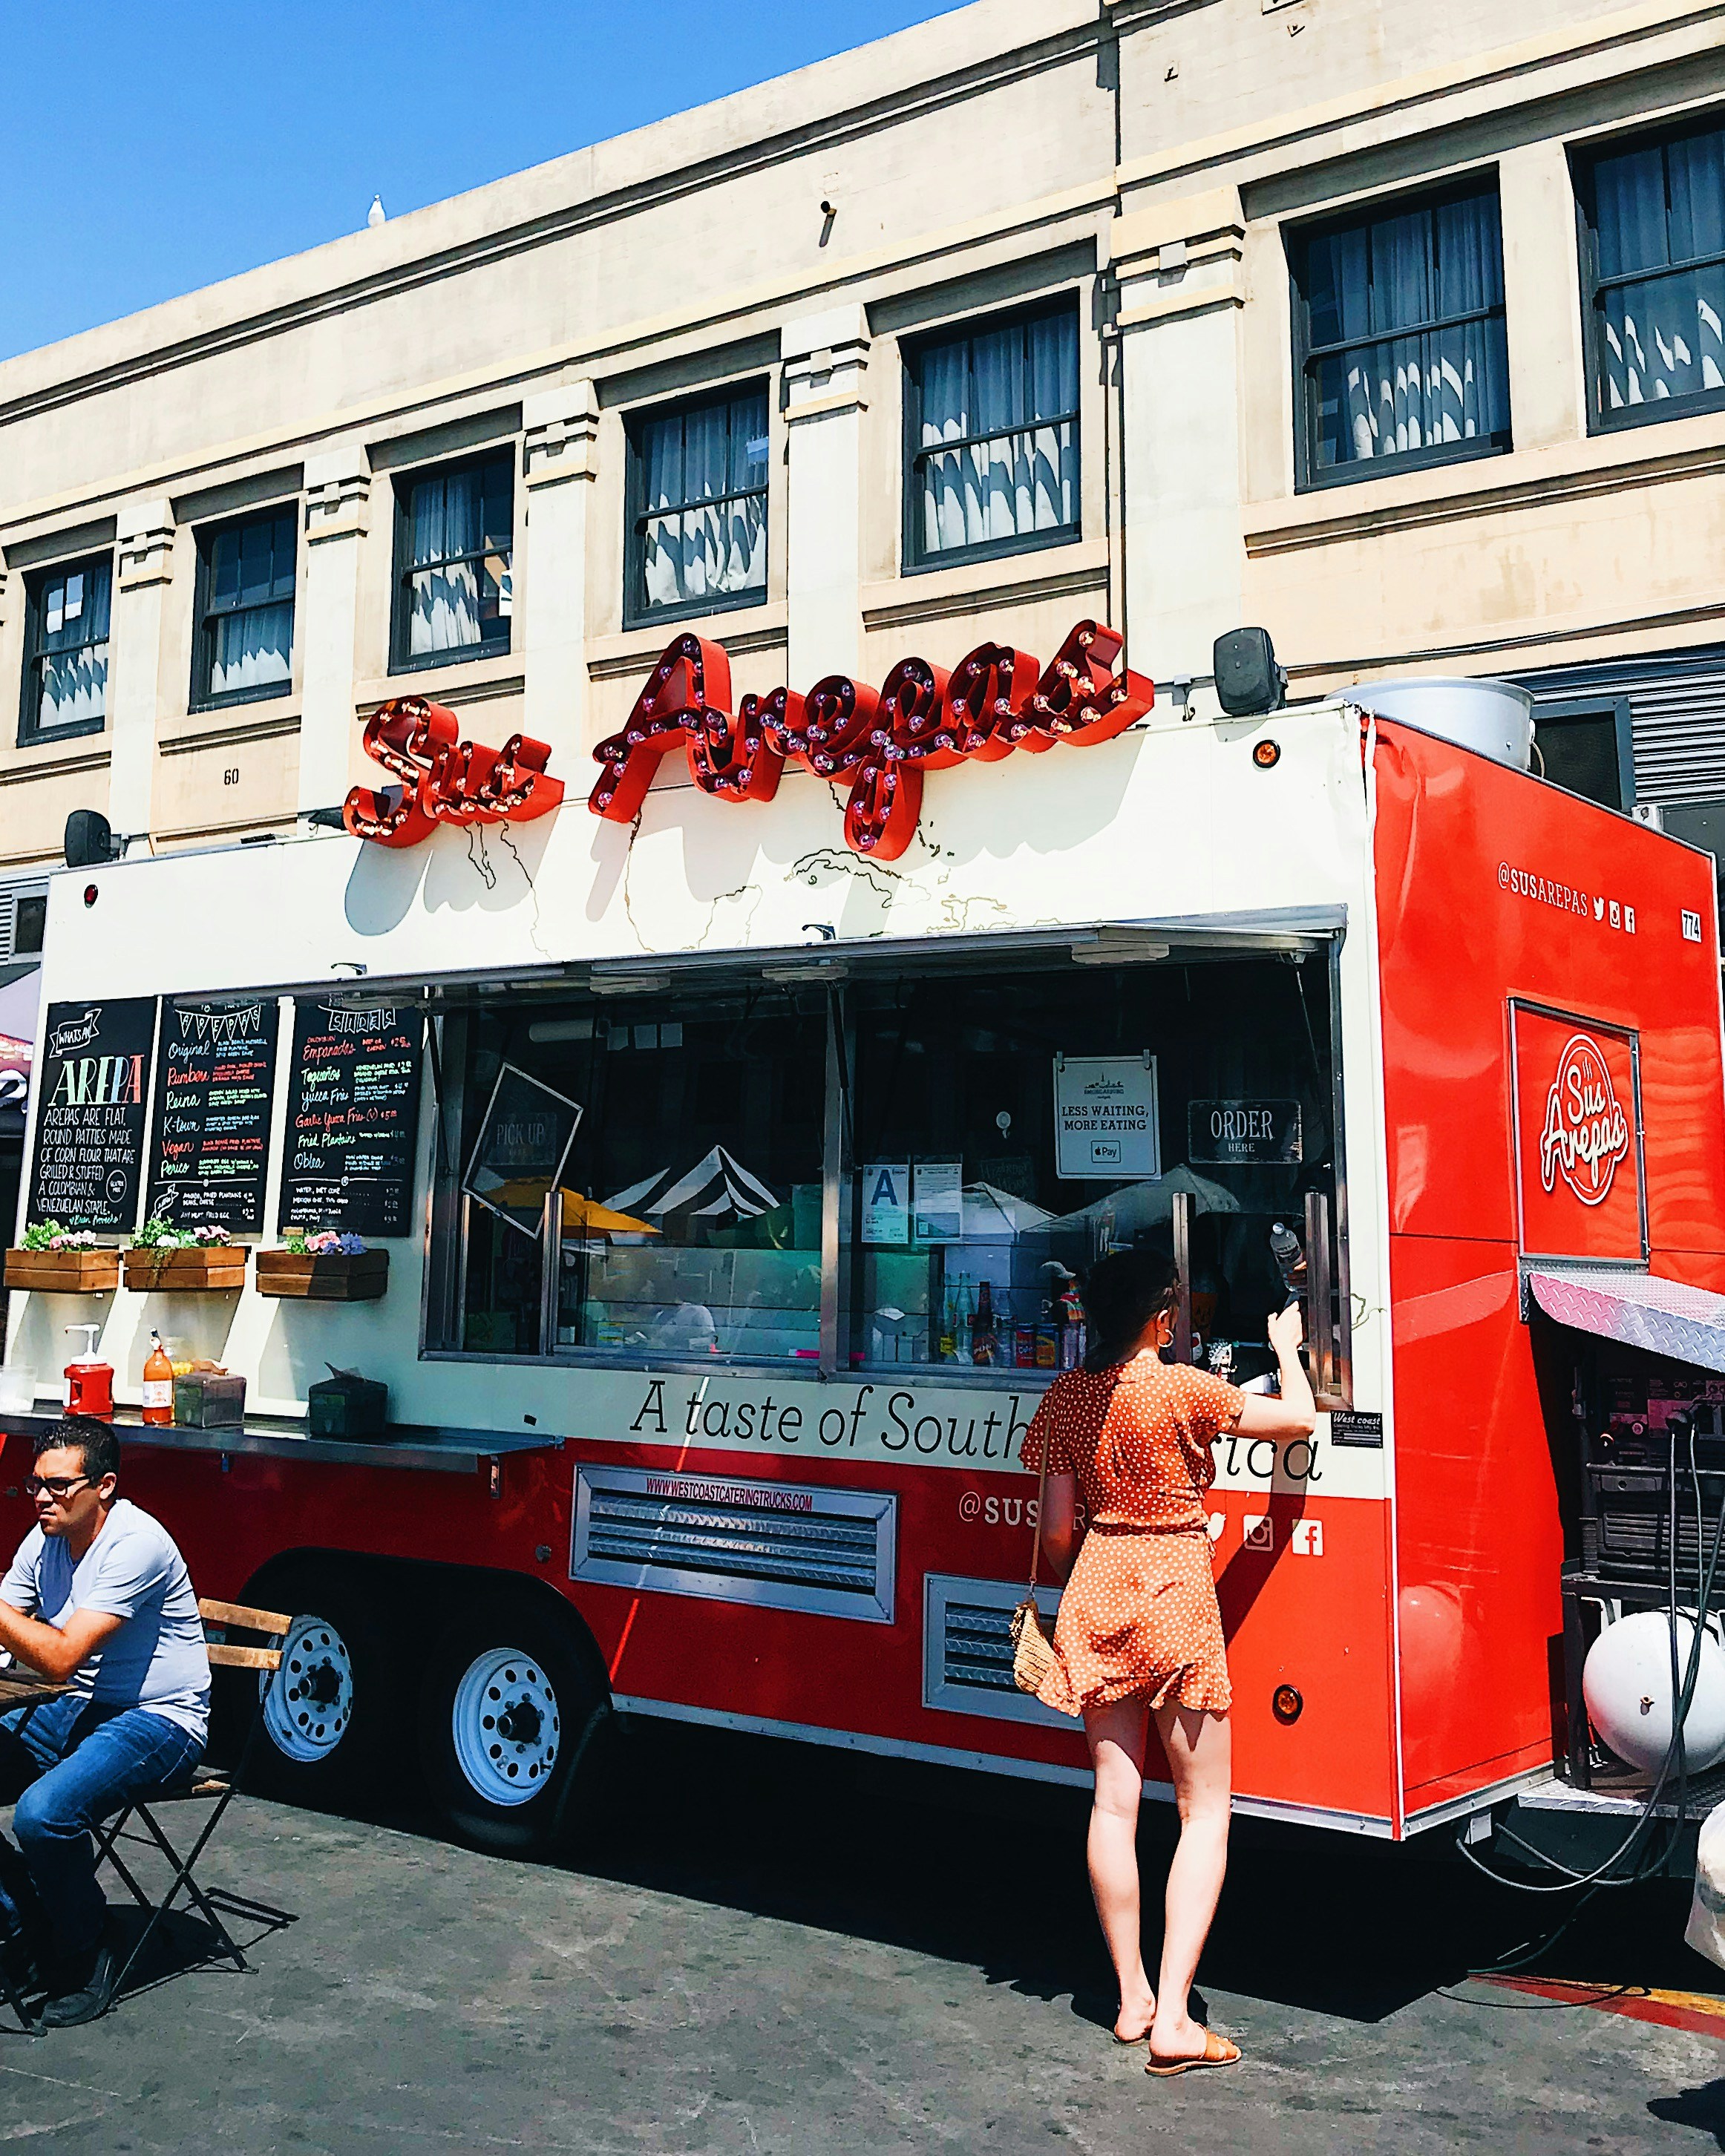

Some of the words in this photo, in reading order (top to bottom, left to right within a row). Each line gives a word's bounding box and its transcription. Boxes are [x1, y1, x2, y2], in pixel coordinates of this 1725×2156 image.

[587, 618, 1155, 862] Arepas
[223, 767, 239, 785] 60
[1497, 862, 1588, 917] @SUSAREPAS
[1683, 913, 1700, 939] 774
[168, 1040, 210, 1064] Original
[303, 1039, 356, 1065] Empanadas
[48, 1054, 145, 1107] AREPA
[166, 1091, 201, 1110] Reina
[1567, 1064, 1606, 1124] Sus
[43, 1107, 80, 1127] AREPAS
[82, 1107, 101, 1126] ARE
[295, 1113, 322, 1128] Garlic
[1061, 1106, 1088, 1117] LESS
[1090, 1104, 1150, 1118] WAITING,
[163, 1115, 200, 1136] K-town
[497, 1123, 524, 1146] PICK
[528, 1122, 546, 1147] UP
[1064, 1120, 1099, 1131] MORE
[1100, 1119, 1147, 1130] EATING
[1210, 1110, 1274, 1141] ORDER
[43, 1128, 73, 1145] ROUND
[75, 1127, 106, 1144] PATTIES
[108, 1129, 133, 1144] MADE
[298, 1133, 319, 1148] Fried
[321, 1132, 356, 1148] Plantains
[1544, 1093, 1625, 1189] Arepas
[40, 1147, 53, 1163] OF
[54, 1147, 77, 1163] CORN
[79, 1148, 101, 1163] FLOUR
[104, 1148, 122, 1163] THAT
[122, 1149, 136, 1164] ARE
[162, 1139, 194, 1161] Vegan
[1102, 1147, 1117, 1158] Pay
[1228, 1143, 1255, 1153] HERE
[160, 1160, 189, 1178] Perico
[293, 1152, 325, 1170] Oblea
[39, 1164, 68, 1179] GRILLED
[75, 1165, 105, 1181] STUFFED
[38, 1181, 46, 1196] A
[871, 1169, 898, 1206] A
[36, 1198, 84, 1213] VENEZUELAN
[629, 1380, 668, 1433] A
[685, 1391, 803, 1444] taste
[819, 1385, 874, 1447] of
[880, 1392, 1031, 1459] South
[1333, 1412, 1355, 1423] West
[1357, 1417, 1381, 1425] coast
[646, 1477, 813, 1511] WWW.WESTCOASTCATERINGTRUCKS.COM
